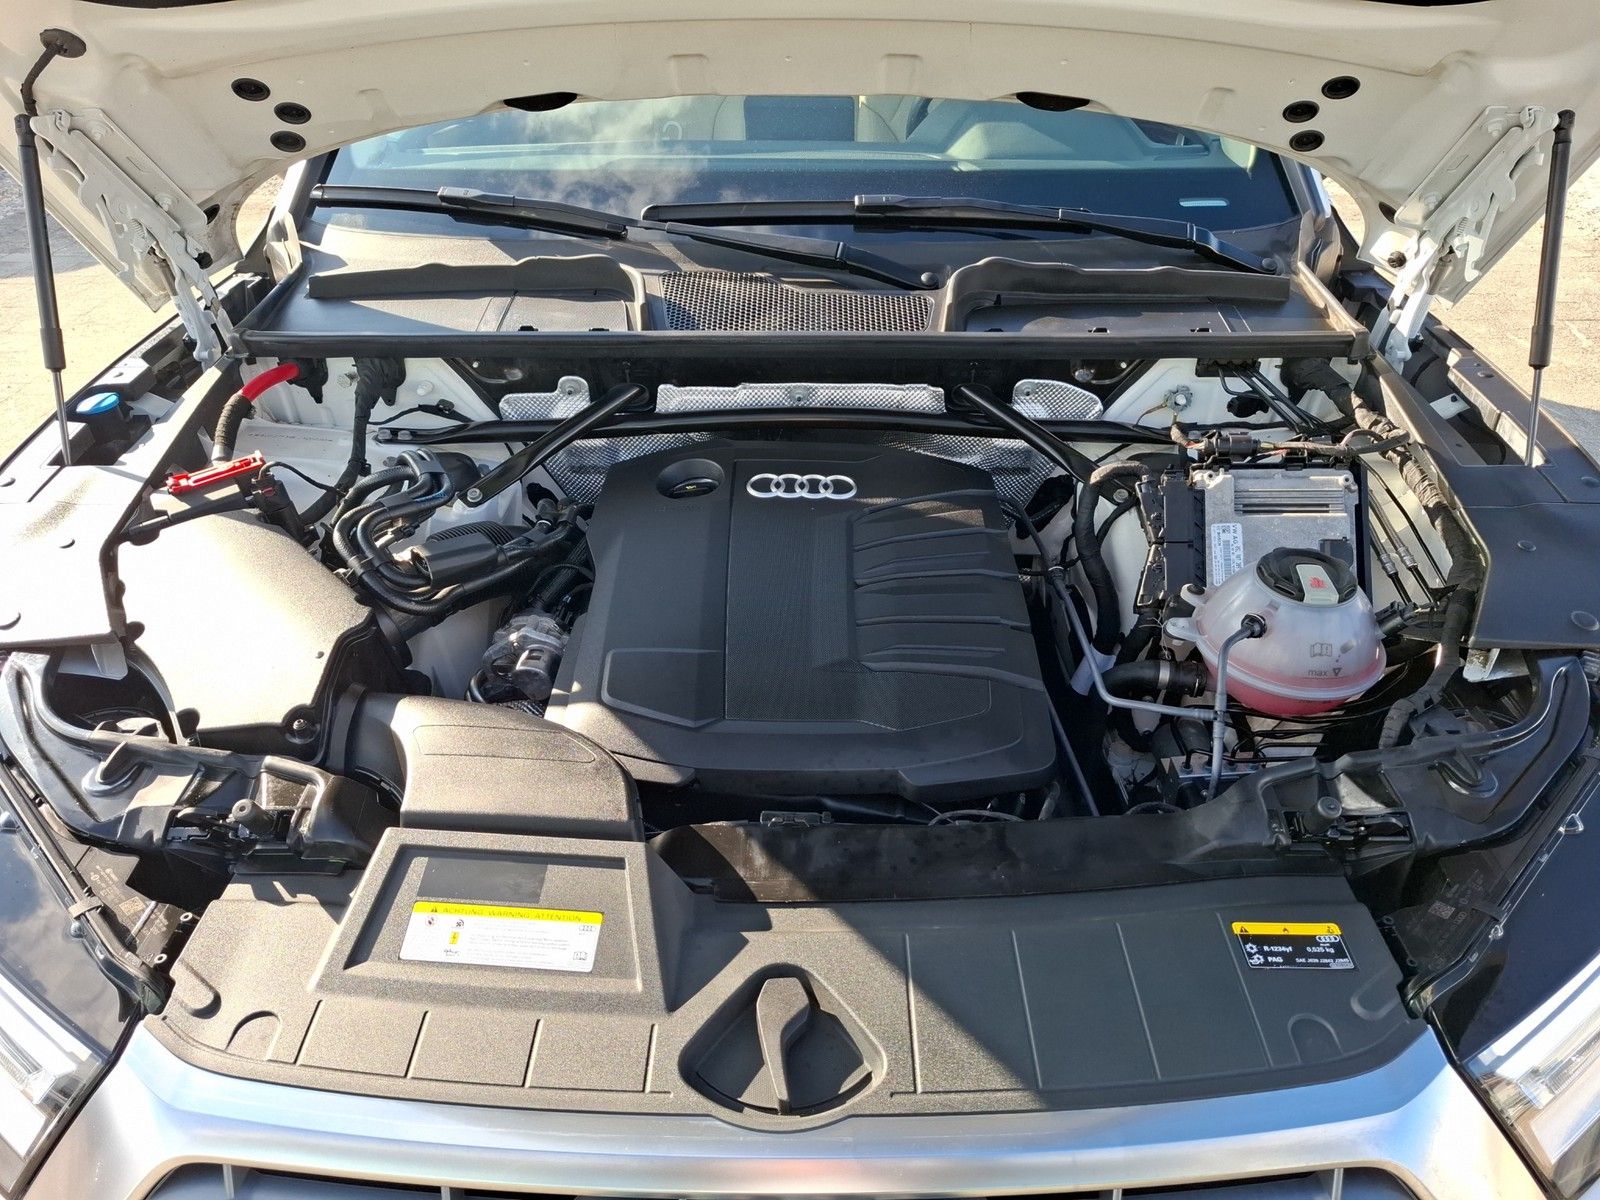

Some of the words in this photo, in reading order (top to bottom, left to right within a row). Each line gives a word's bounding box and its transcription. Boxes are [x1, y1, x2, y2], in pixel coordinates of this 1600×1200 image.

[1308, 669, 1328, 677] max
[442, 907, 484, 916] ACHTUNG
[488, 909, 530, 919] WARNING
[535, 912, 582, 923] ATTENTION
[1263, 945, 1293, 953] R-1234yf
